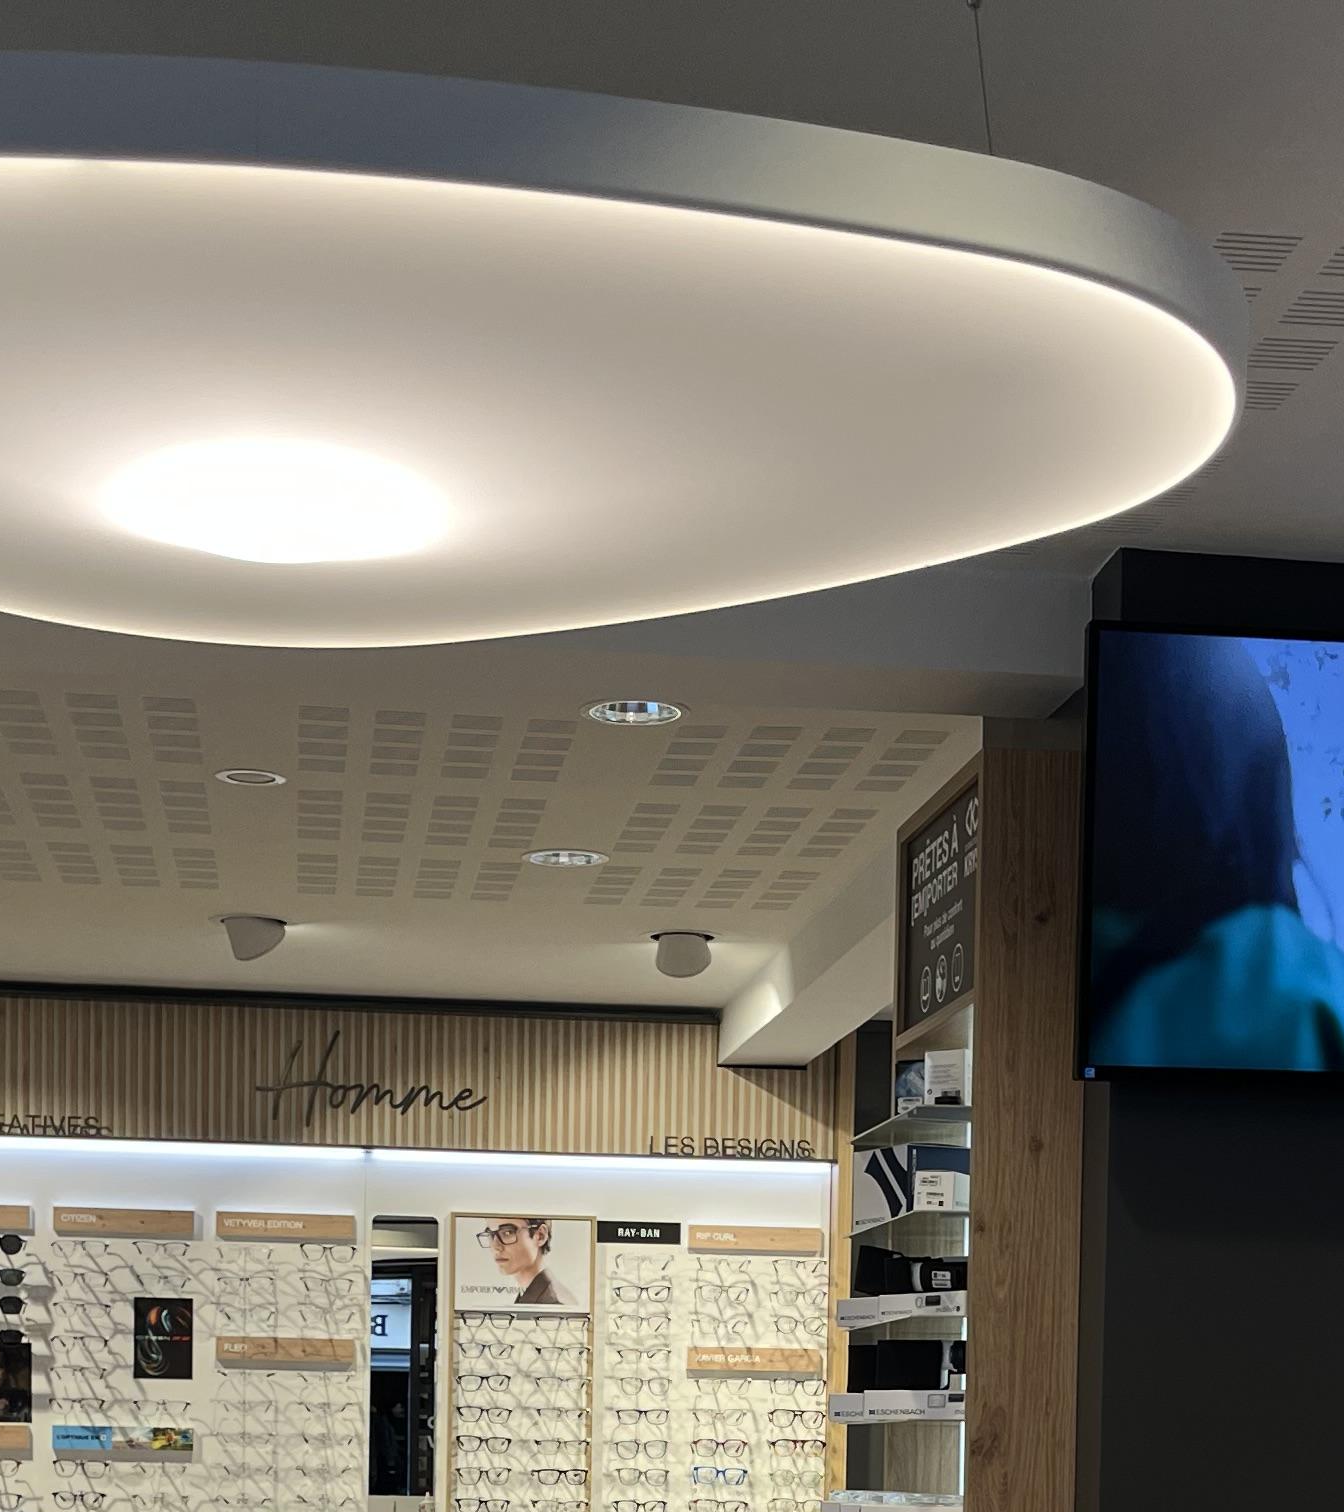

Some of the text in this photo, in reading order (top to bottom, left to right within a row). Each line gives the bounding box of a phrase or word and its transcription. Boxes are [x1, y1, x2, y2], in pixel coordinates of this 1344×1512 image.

[256, 1030, 488, 1127] Homme
[650, 1135, 813, 1159] LES DESIGNS
[876, 1408, 926, 1416] ESCHENBACH
